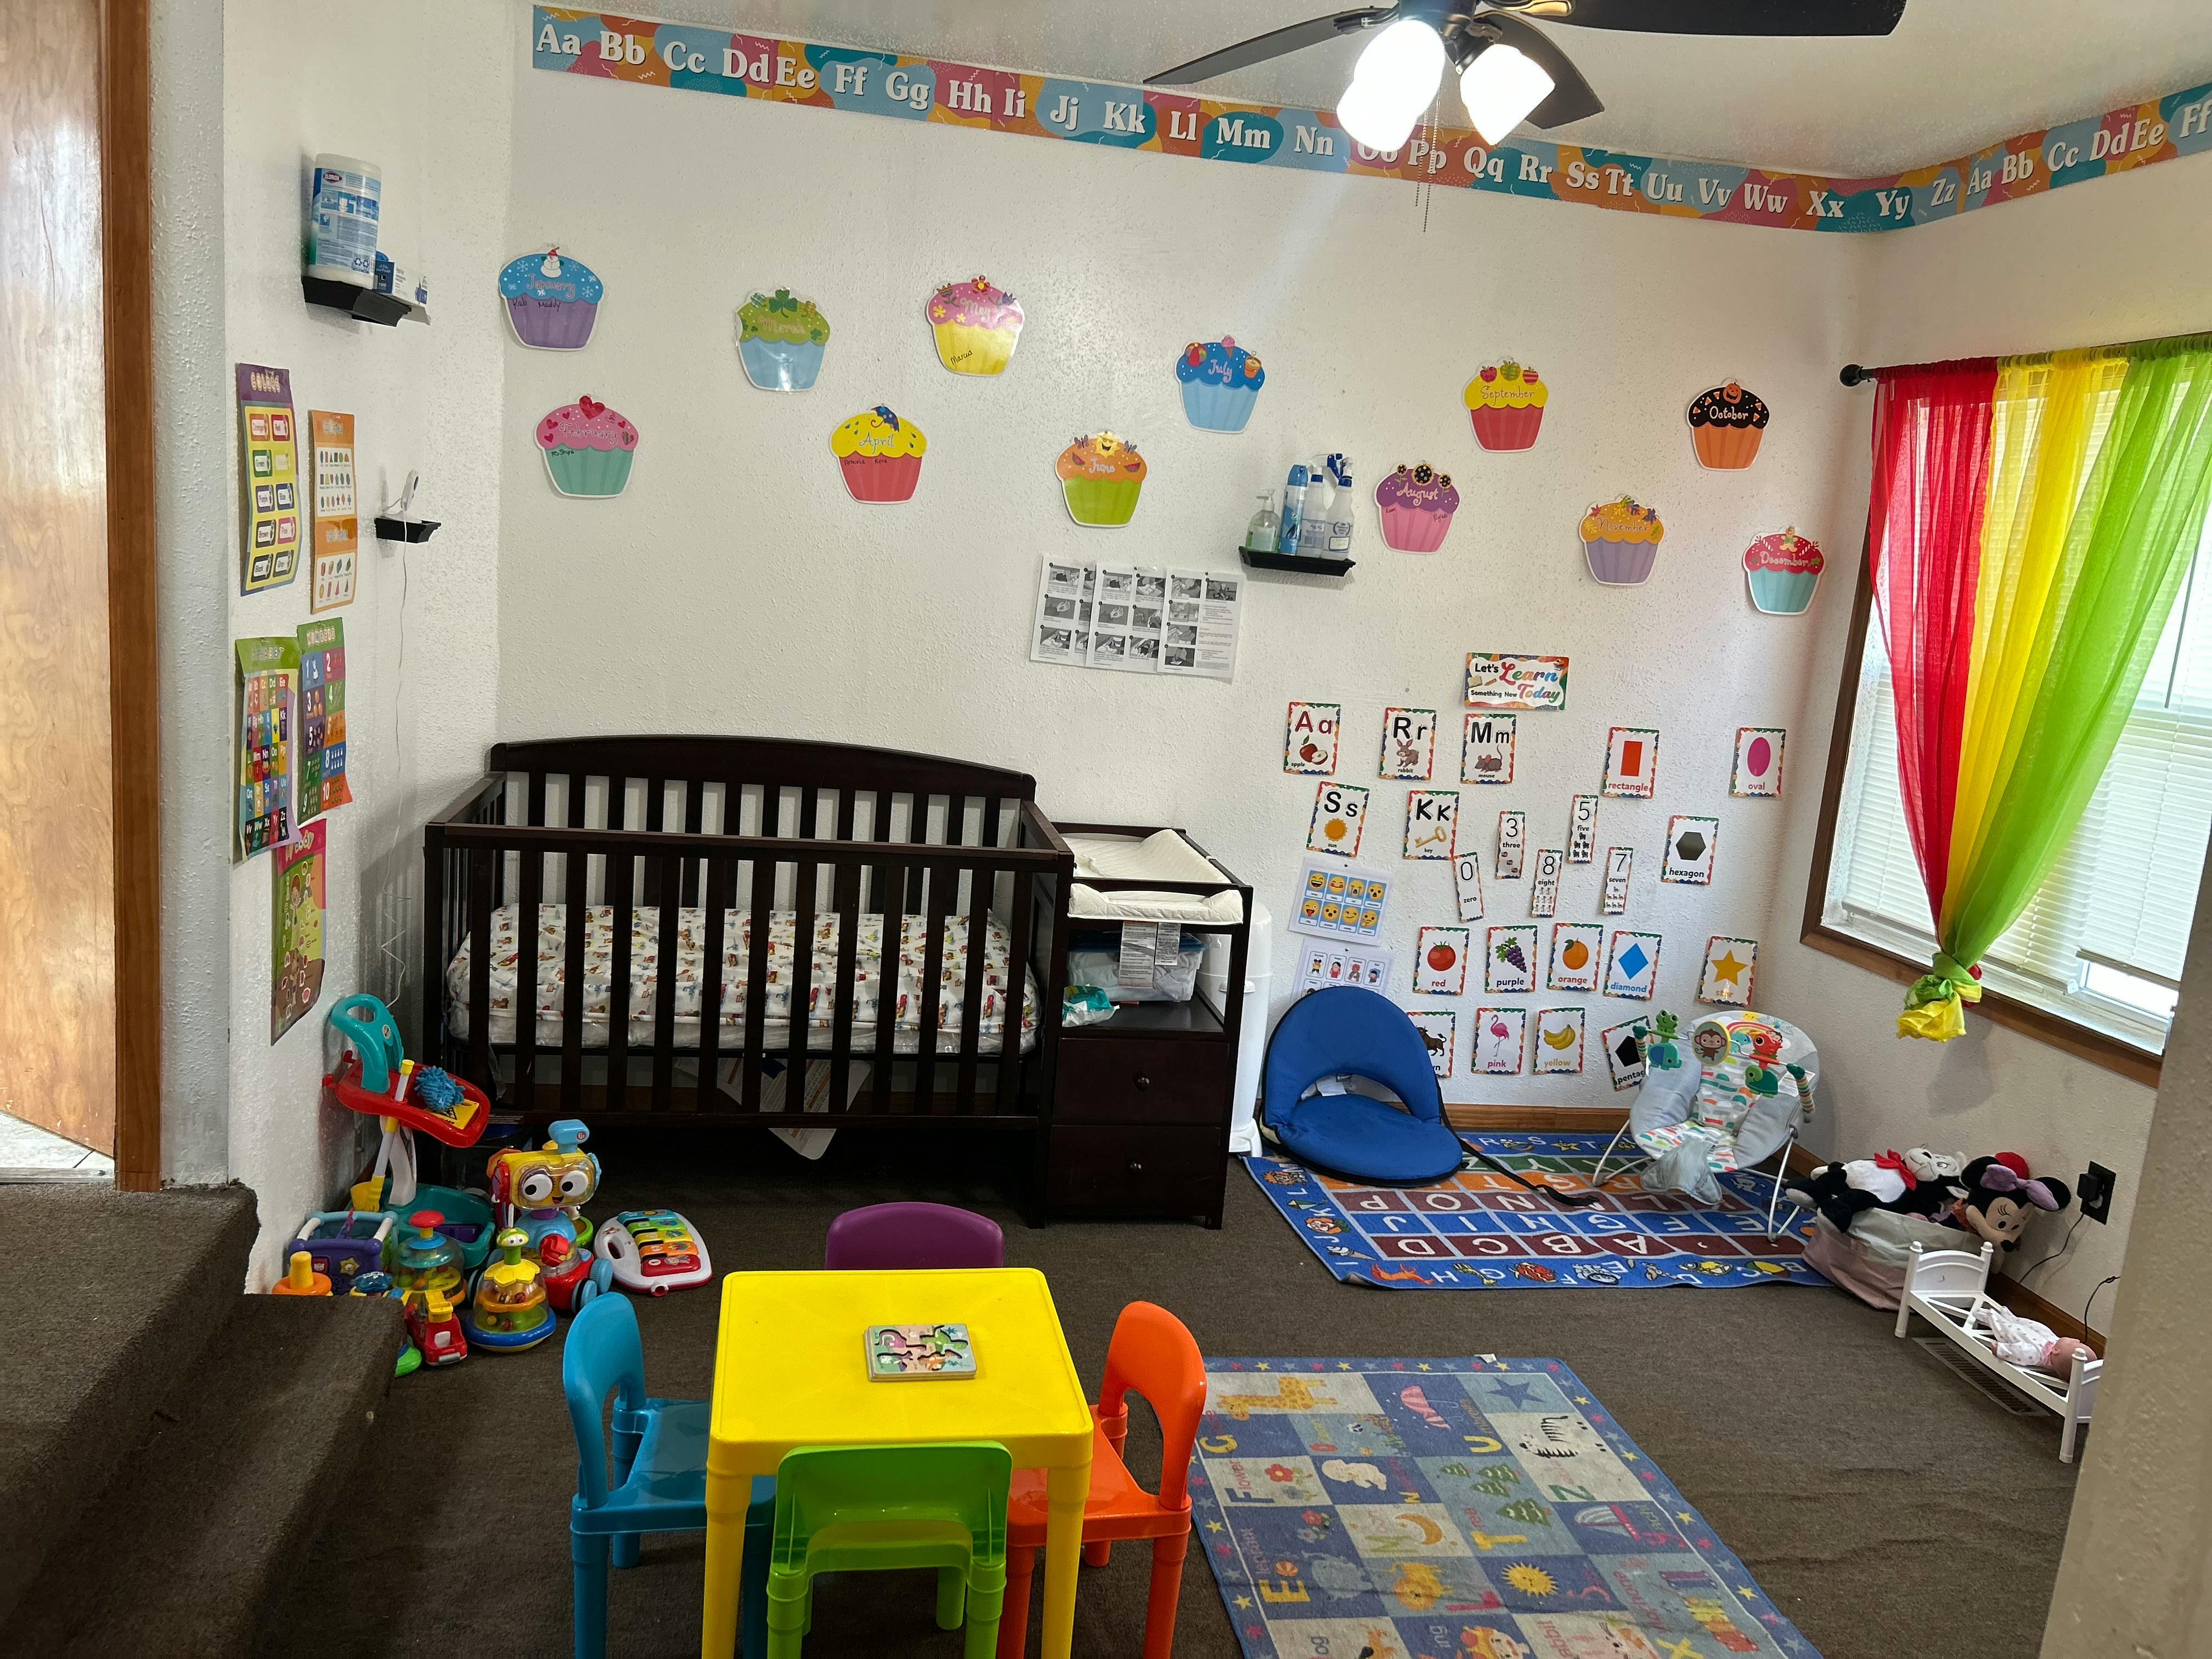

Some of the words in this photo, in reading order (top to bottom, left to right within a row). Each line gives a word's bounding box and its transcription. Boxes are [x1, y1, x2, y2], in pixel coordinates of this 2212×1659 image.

[536, 24, 581, 55] Aa
[599, 31, 646, 65] Bb
[663, 41, 705, 73] Cc
[721, 48, 770, 83] Dd
[775, 57, 815, 88] Ee
[834, 64, 868, 95] Ff
[881, 71, 930, 110] Gg
[947, 80, 992, 113] Hh
[1003, 88, 1026, 119] Ii
[1050, 95, 1080, 131] Jj
[1102, 100, 1146, 134] Kk
[1169, 111, 1197, 142] Ll
[1216, 117, 1271, 150] Mm
[1295, 125, 1335, 157] Nn
[1407, 139, 1448, 175] Pp
[1463, 146, 1504, 183] Qq
[1518, 154, 1553, 184] Rr
[1566, 161, 1600, 190] Ss
[1605, 168, 1634, 198] Tt
[1647, 173, 1683, 203] Uu
[1698, 178, 1733, 207] Vv
[1743, 183, 1788, 213] Ww
[1806, 190, 1845, 219] Xx
[1875, 191, 1911, 221] Yy
[1931, 178, 1957, 207] Zz
[1966, 167, 1993, 196] Aa
[2001, 151, 2034, 185] Bb
[2047, 142, 2079, 172] Cc
[2089, 122, 2130, 161] Dd
[2129, 118, 2165, 151] Ee
[2179, 99, 2212, 138] Ff
[527, 273, 575, 299] January
[950, 350, 973, 365] Marcus
[1208, 359, 1233, 382] July
[1480, 385, 1534, 407] September
[1709, 405, 1748, 420] October
[559, 422, 618, 446] February
[859, 431, 894, 454] April
[1088, 458, 1115, 474] June
[1396, 482, 1438, 506] August
[1596, 517, 1649, 532] November
[1759, 551, 1809, 567] December
[306, 659, 309, 679] 1
[326, 653, 331, 672] 2
[1475, 663, 1499, 673] Let's
[1499, 662, 1558, 685] Learn
[269, 678, 276, 688] Dd
[280, 678, 286, 687] Ee
[307, 692, 312, 712] 3
[329, 685, 332, 704] 4
[1471, 690, 1502, 698] Something
[1517, 684, 1560, 703] Today
[280, 709, 286, 720] Kk
[1295, 711, 1333, 734] Aa
[1393, 716, 1427, 740] Rr
[309, 726, 313, 746] 5
[328, 716, 331, 735] 6
[1471, 721, 1509, 743] Mm
[307, 761, 311, 780] 7
[325, 749, 330, 768] 8
[1609, 782, 1649, 792] rectangle
[303, 793, 308, 812] 9
[323, 782, 330, 801] 10
[1324, 791, 1358, 817] Ss
[1416, 798, 1451, 821] Kk
[1578, 801, 1590, 821] 5
[1506, 818, 1517, 837] 3
[1543, 855, 1555, 875] 8
[1615, 853, 1627, 872] 7
[1669, 867, 1705, 878] hexagon
[1431, 979, 1446, 988] red
[1497, 978, 1524, 988] purple
[1558, 977, 1587, 985] orange
[1610, 982, 1647, 992] diamond
[1487, 1059, 1506, 1068] pink
[1544, 1059, 1571, 1067] yellow
[1478, 1137, 1498, 1146] R
[1527, 1136, 1546, 1145] S
[1579, 1141, 1596, 1149] T
[1527, 1158, 1555, 1172] Y
[1483, 1176, 1511, 1189] T
[1544, 1174, 1576, 1189] S
[1360, 1195, 1390, 1210] P
[1426, 1194, 1462, 1210] O
[1496, 1195, 1536, 1210] N
[1632, 1195, 1668, 1210] L
[1308, 1207, 1335, 1216] K
[1382, 1216, 1407, 1231] J
[1458, 1216, 1478, 1231] I
[1588, 1215, 1627, 1229] G
[1663, 1216, 1691, 1231] F
[1397, 1238, 1436, 1255] D
[1472, 1238, 1509, 1254] C
[1542, 1235, 1582, 1254] B
[1613, 1235, 1647, 1254] A
[1479, 1268, 1506, 1279] G
[1601, 1261, 1629, 1273] E
[1736, 1266, 1762, 1277] C
[1780, 1261, 1807, 1272] B
[1430, 1271, 1459, 1283] H
[1559, 1274, 1578, 1284] F
[1675, 1273, 1703, 1284] D
[1224, 1459, 1275, 1504] Flower
